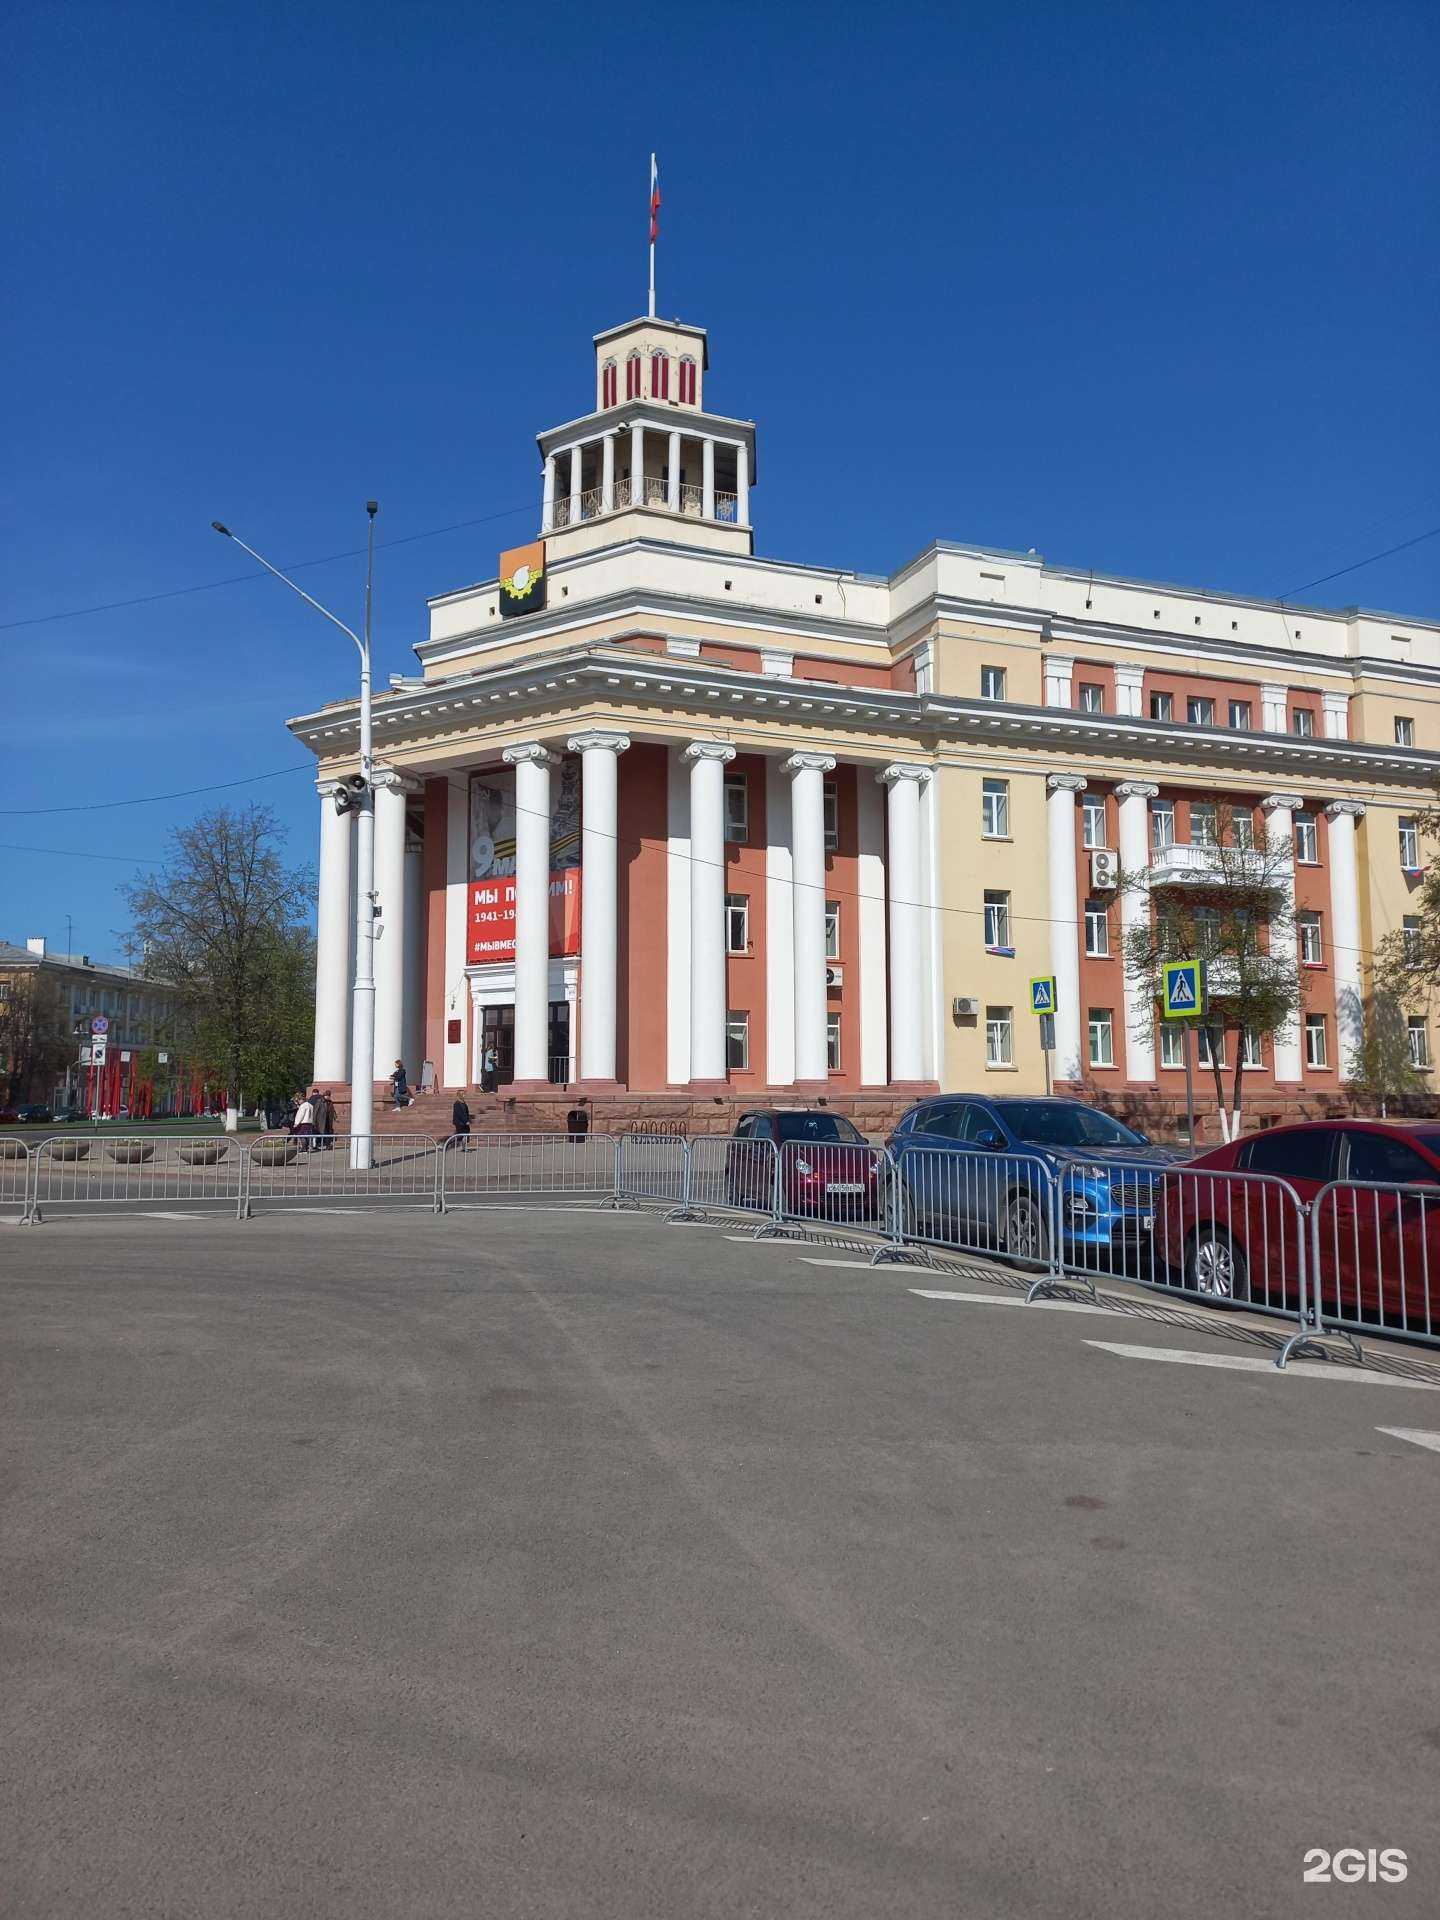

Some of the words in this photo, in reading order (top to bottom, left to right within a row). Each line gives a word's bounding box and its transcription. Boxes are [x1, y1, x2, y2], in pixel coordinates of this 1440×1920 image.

[472, 836, 495, 877] 9
[474, 888, 499, 905] МЫ
[474, 909, 517, 923] 1941-19
